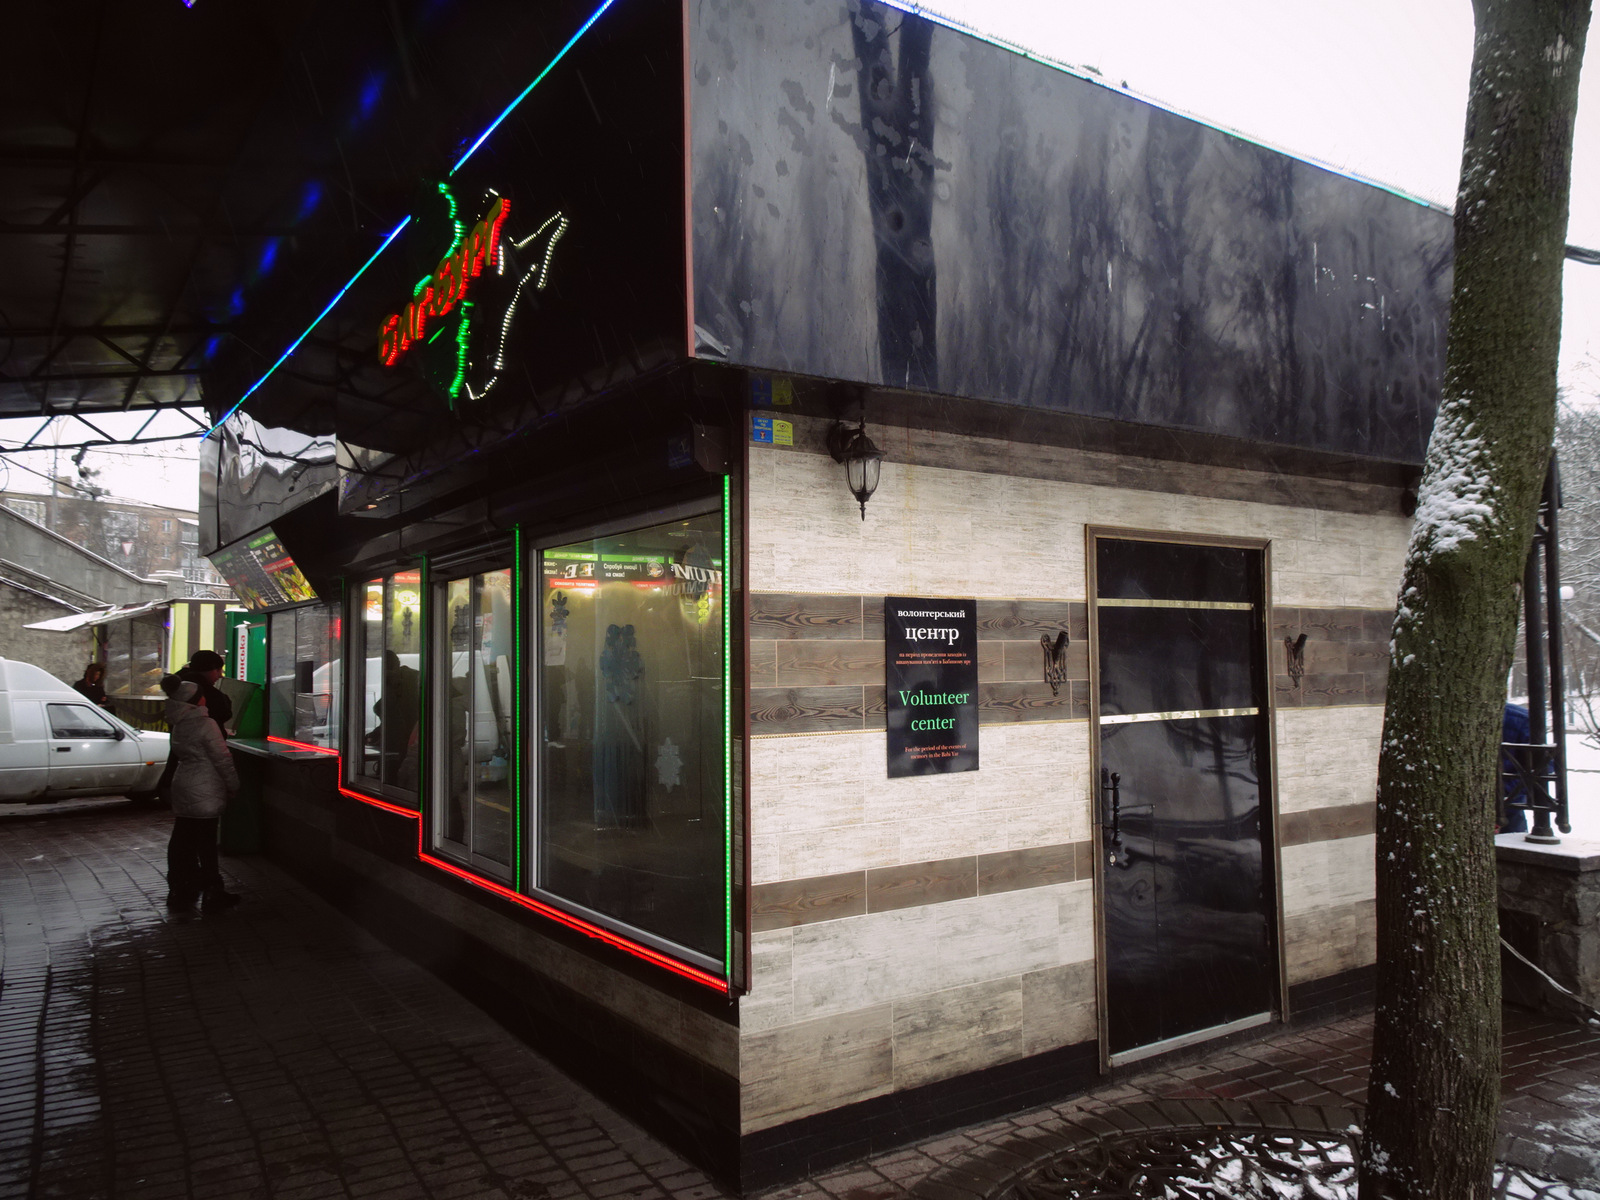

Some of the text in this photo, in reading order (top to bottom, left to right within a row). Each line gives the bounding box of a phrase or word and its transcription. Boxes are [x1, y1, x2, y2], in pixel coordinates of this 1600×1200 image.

[897, 610, 966, 620] волонтерський
[905, 627, 959, 645] центр
[899, 689, 969, 706] Volunteer
[911, 717, 956, 731] center
